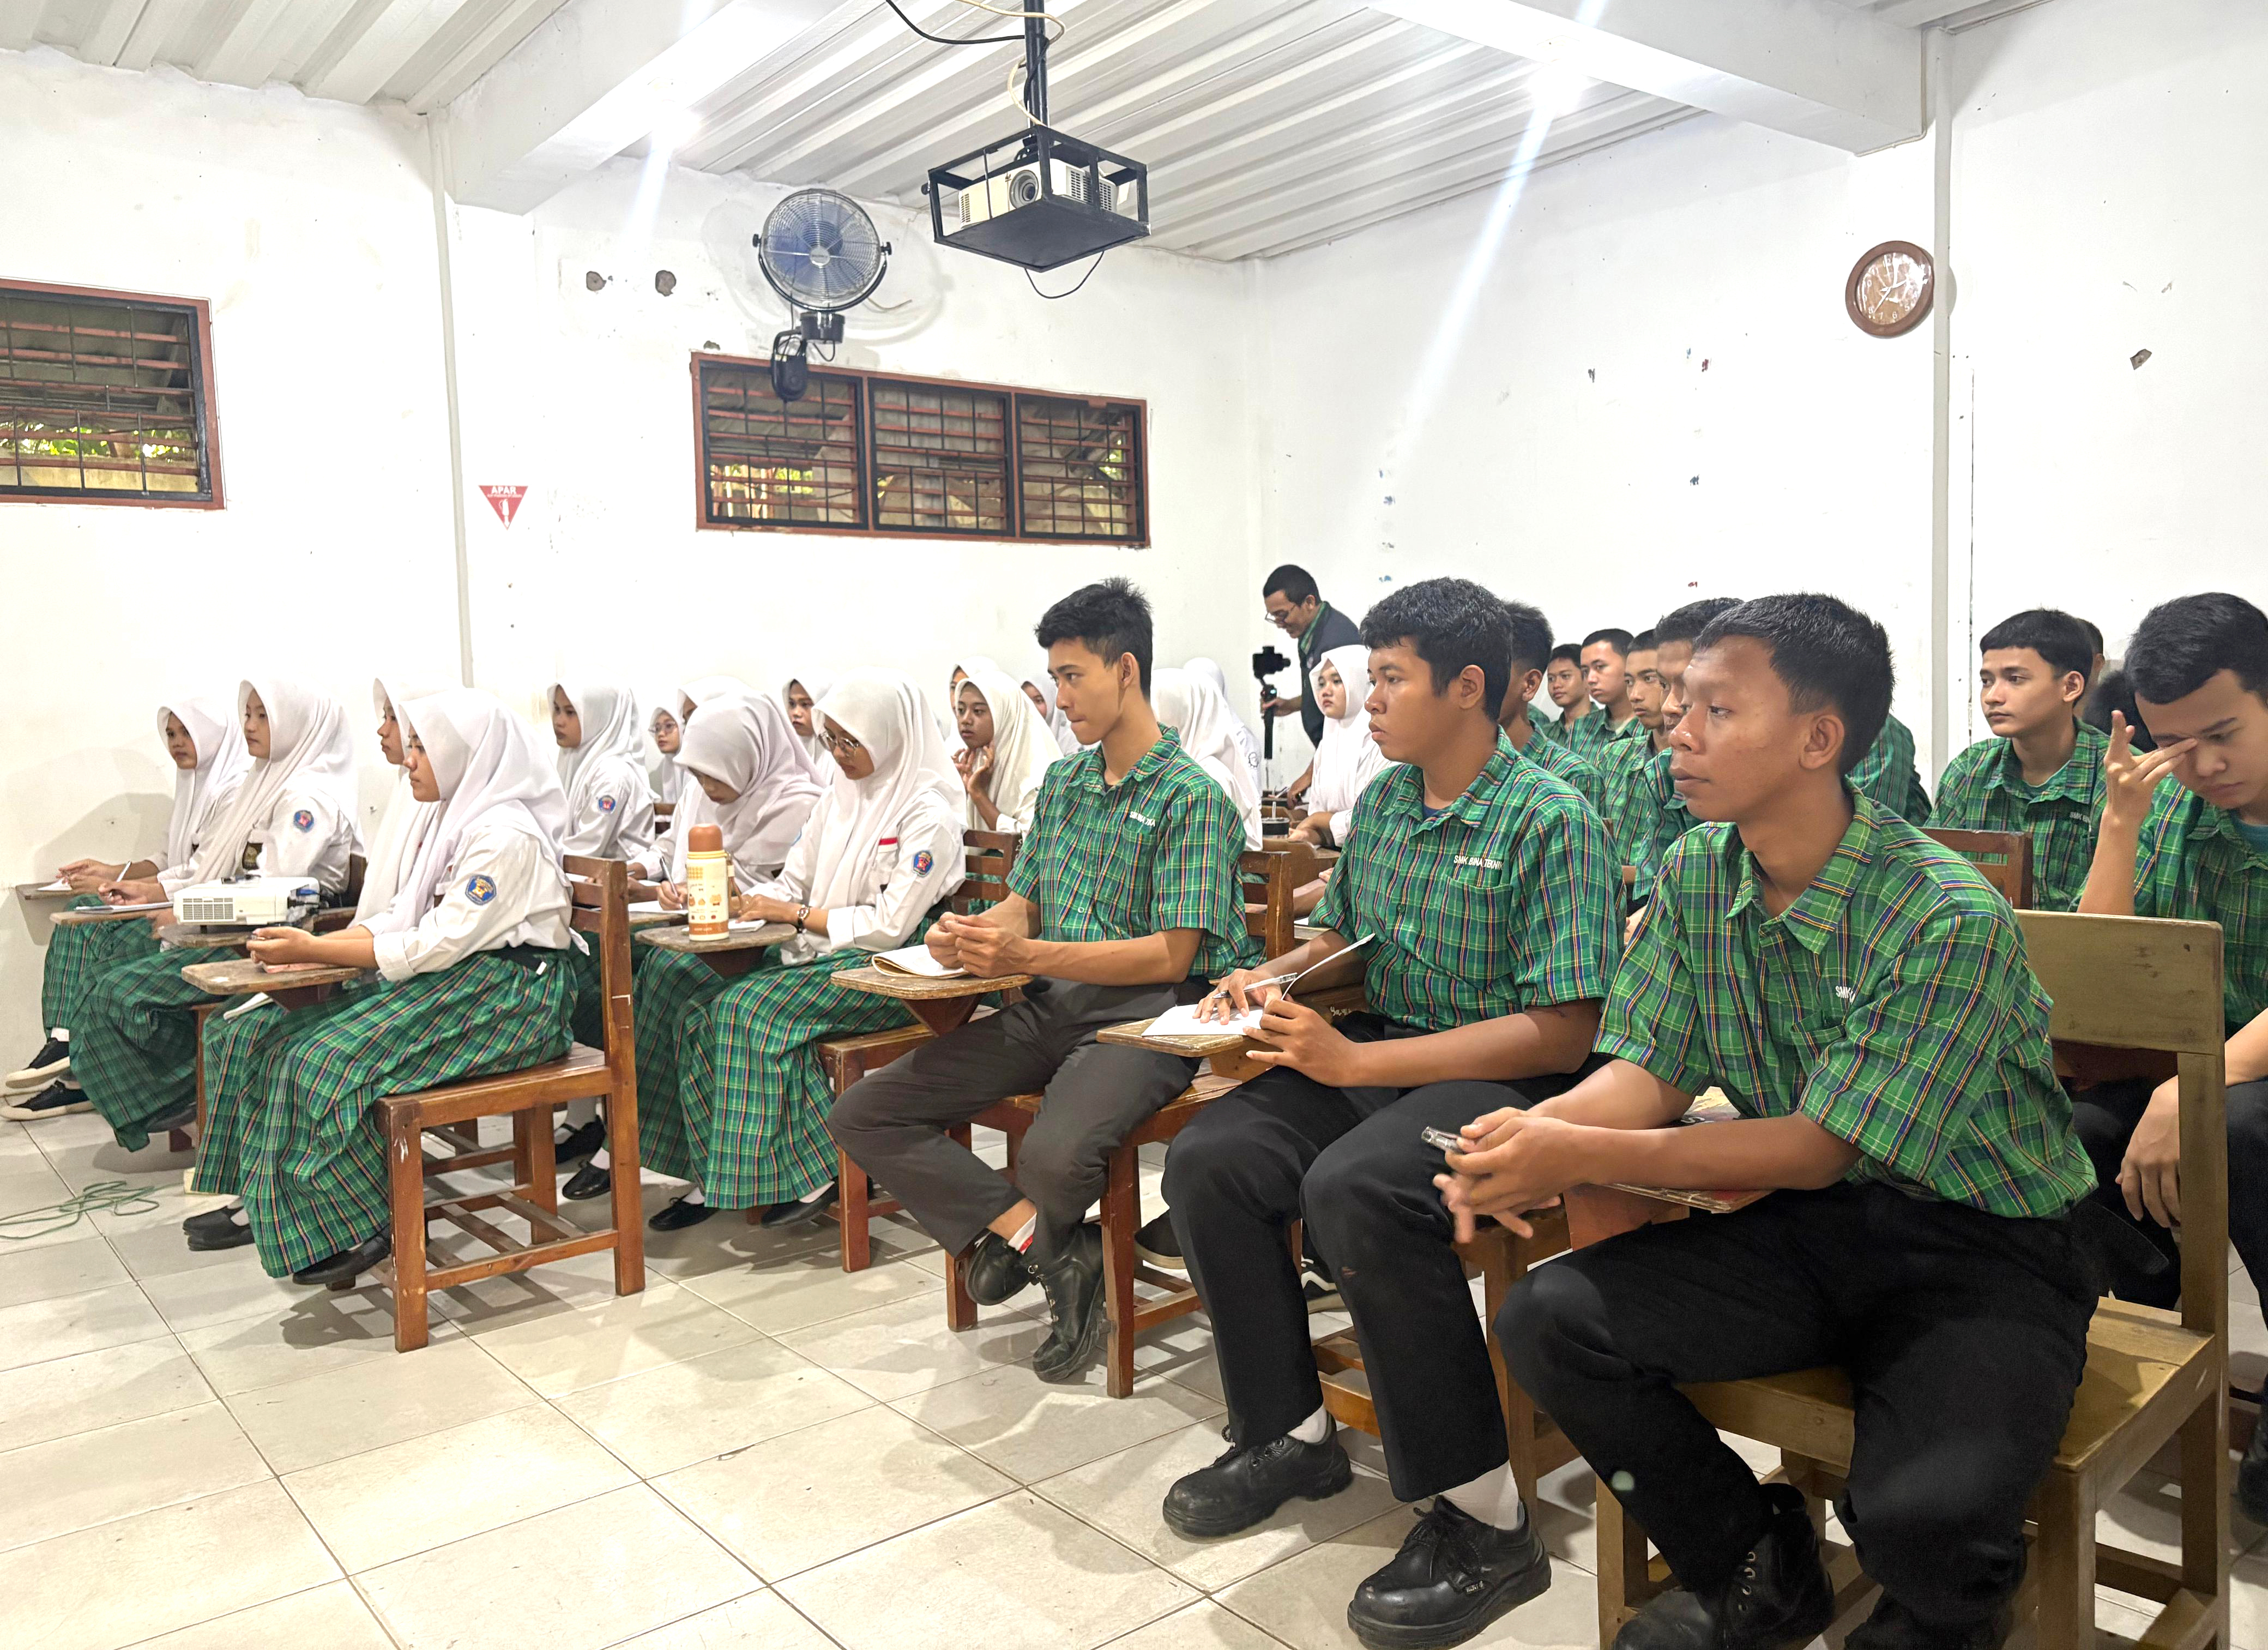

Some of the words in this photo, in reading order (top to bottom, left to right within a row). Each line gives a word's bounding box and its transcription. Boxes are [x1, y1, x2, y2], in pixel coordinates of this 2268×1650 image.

[1892, 311, 1898, 319] 6
[491, 486, 516, 495] APAR
[1453, 855, 1469, 864] SMK
[1468, 857, 1483, 866] BINA
[1835, 985, 1851, 998] SMK
